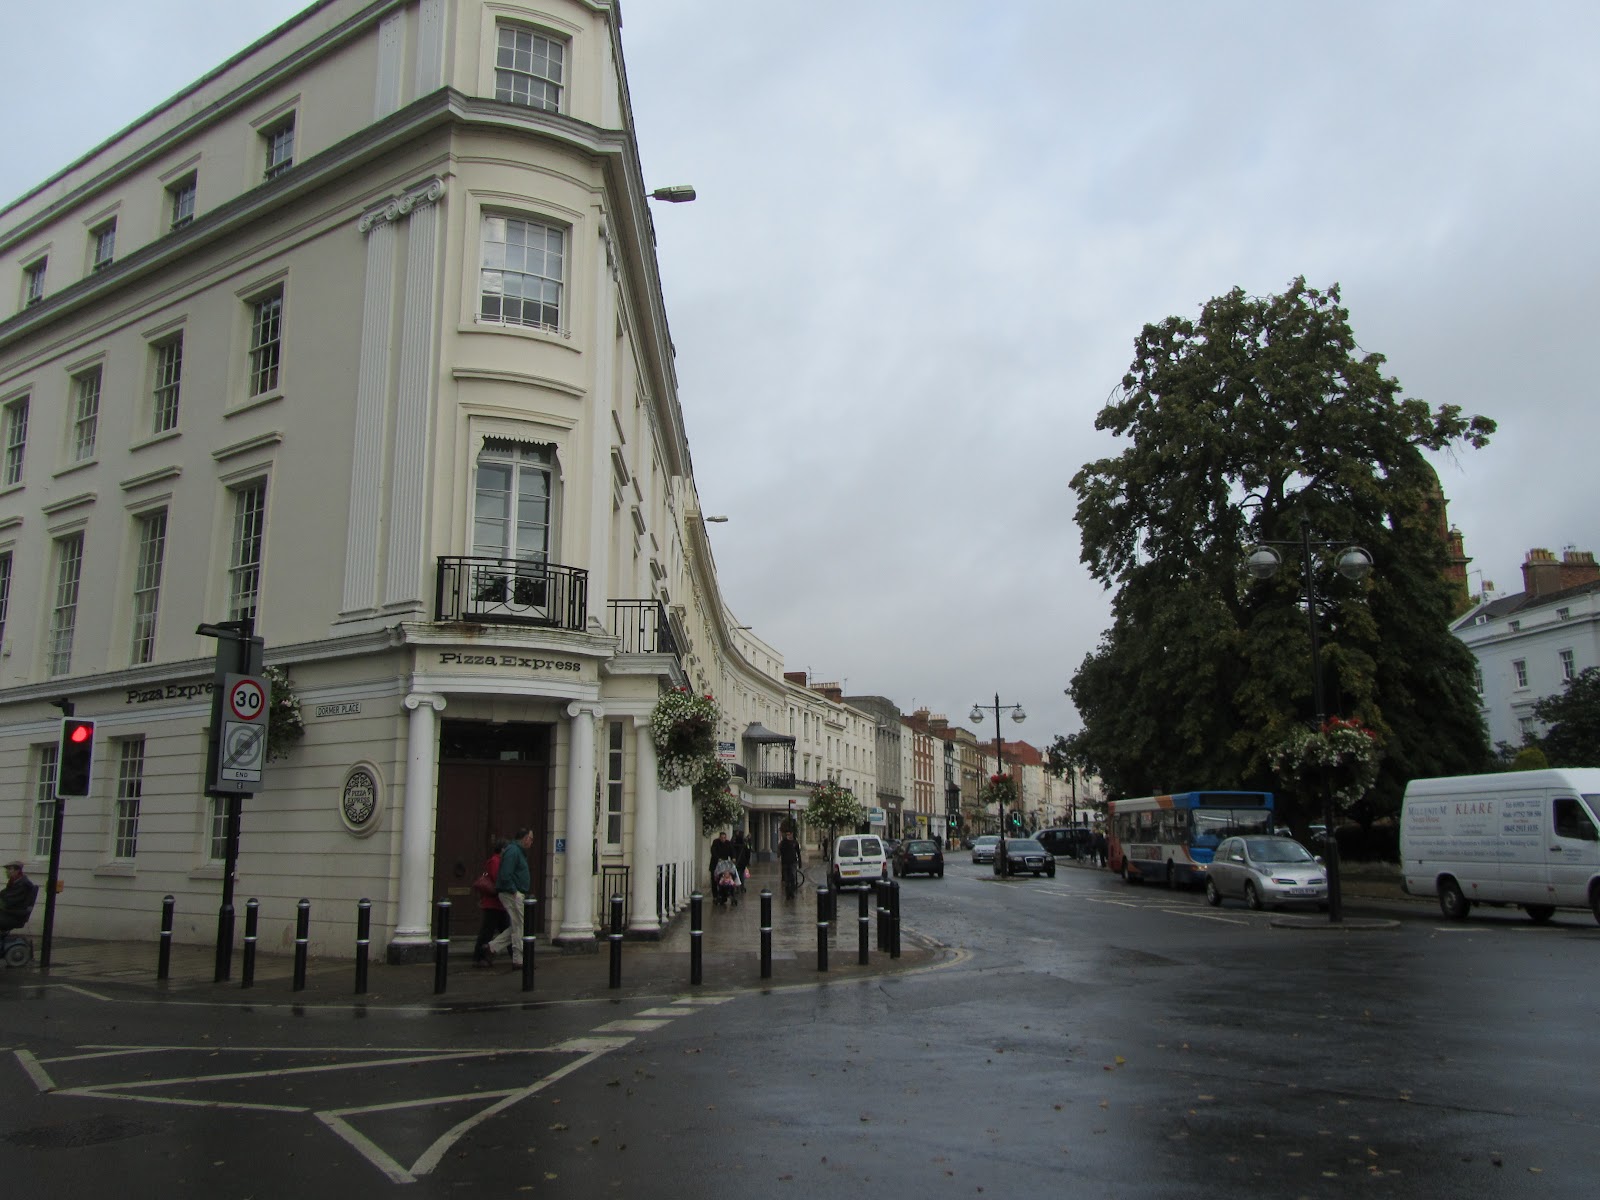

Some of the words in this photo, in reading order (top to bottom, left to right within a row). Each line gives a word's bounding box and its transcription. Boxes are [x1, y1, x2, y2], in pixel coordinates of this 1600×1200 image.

[439, 653, 498, 667] Pizza
[499, 655, 581, 672] Express
[126, 688, 164, 704] Pizza
[165, 682, 214, 699] Expre
[235, 690, 260, 709] 30
[318, 705, 340, 716] DORMER
[341, 703, 359, 714] PLACE
[1455, 801, 1494, 815] KLARE
